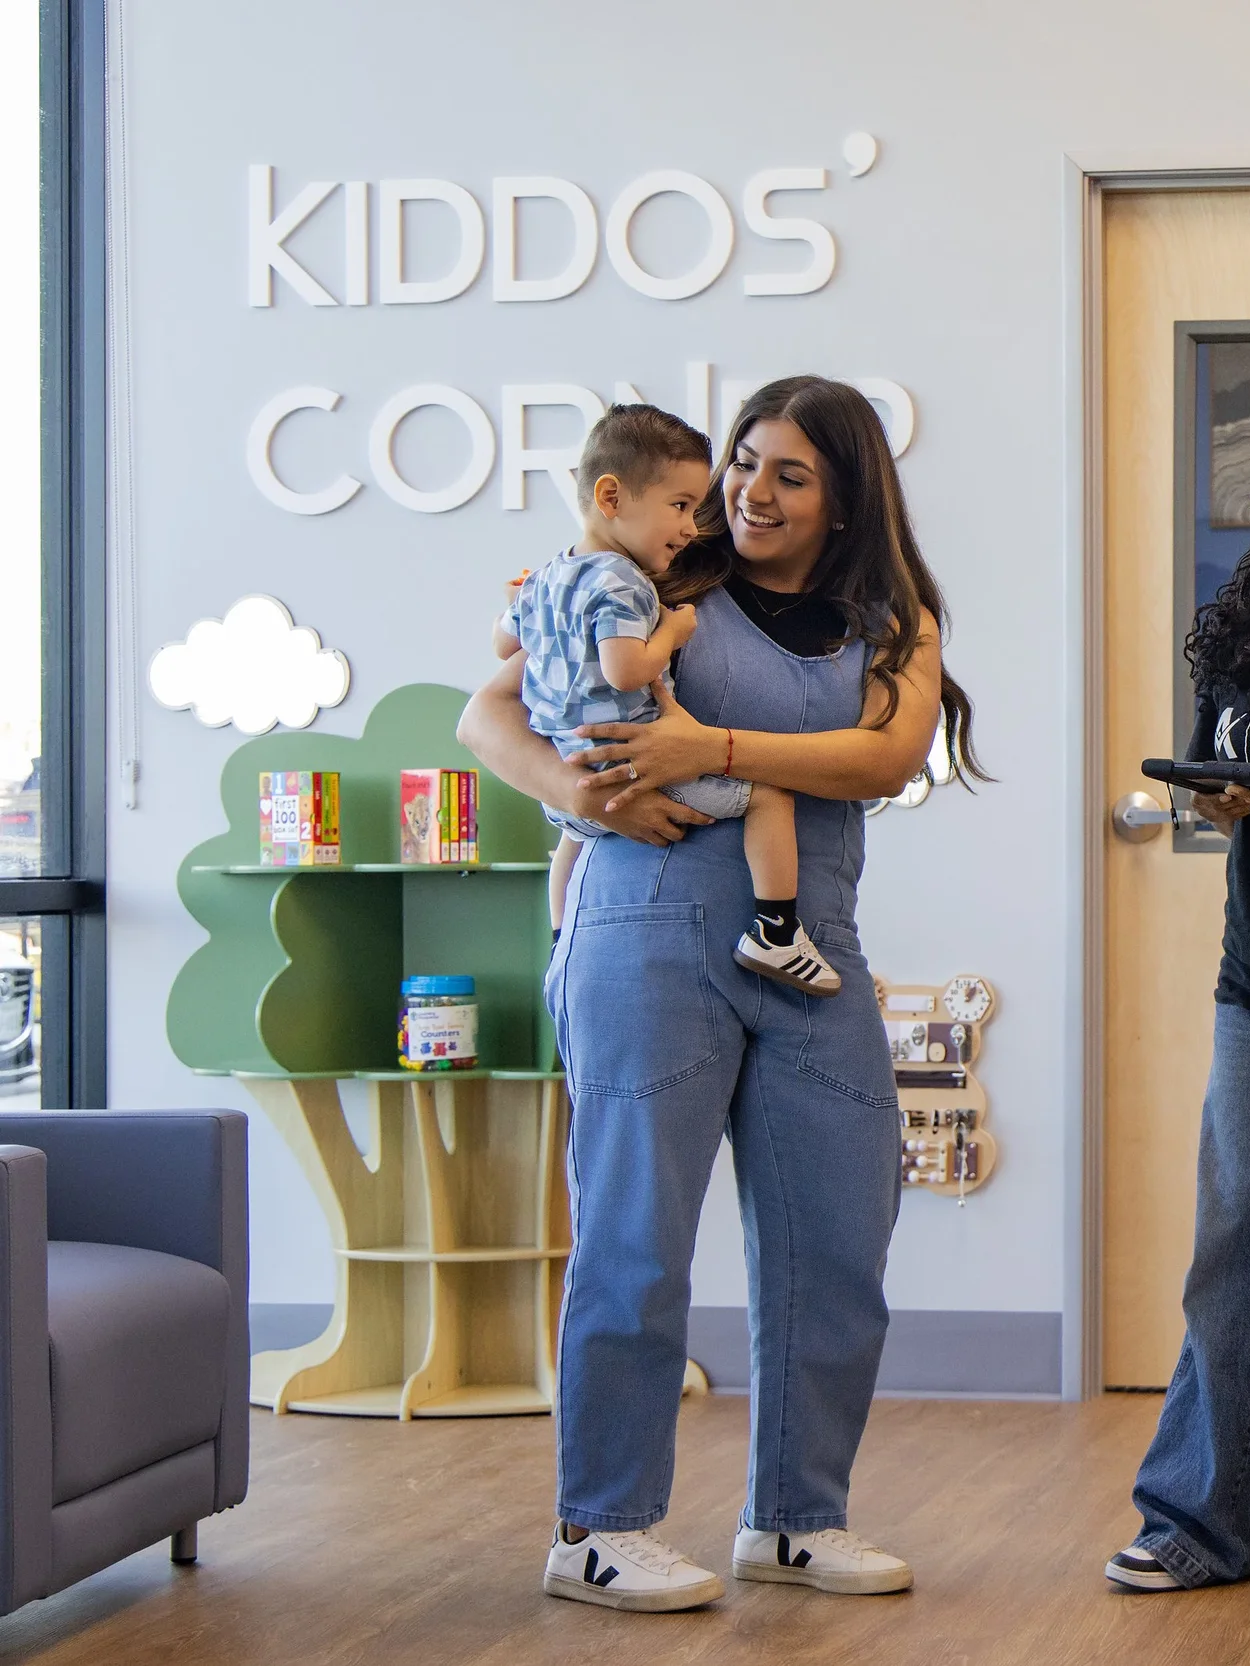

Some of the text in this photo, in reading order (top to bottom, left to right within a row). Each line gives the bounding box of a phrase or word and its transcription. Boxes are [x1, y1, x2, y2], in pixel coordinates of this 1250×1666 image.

[247, 131, 880, 308] KIDDOS'
[246, 361, 914, 532] COR
[275, 810, 296, 824] 100
[421, 1030, 460, 1038] Counters
